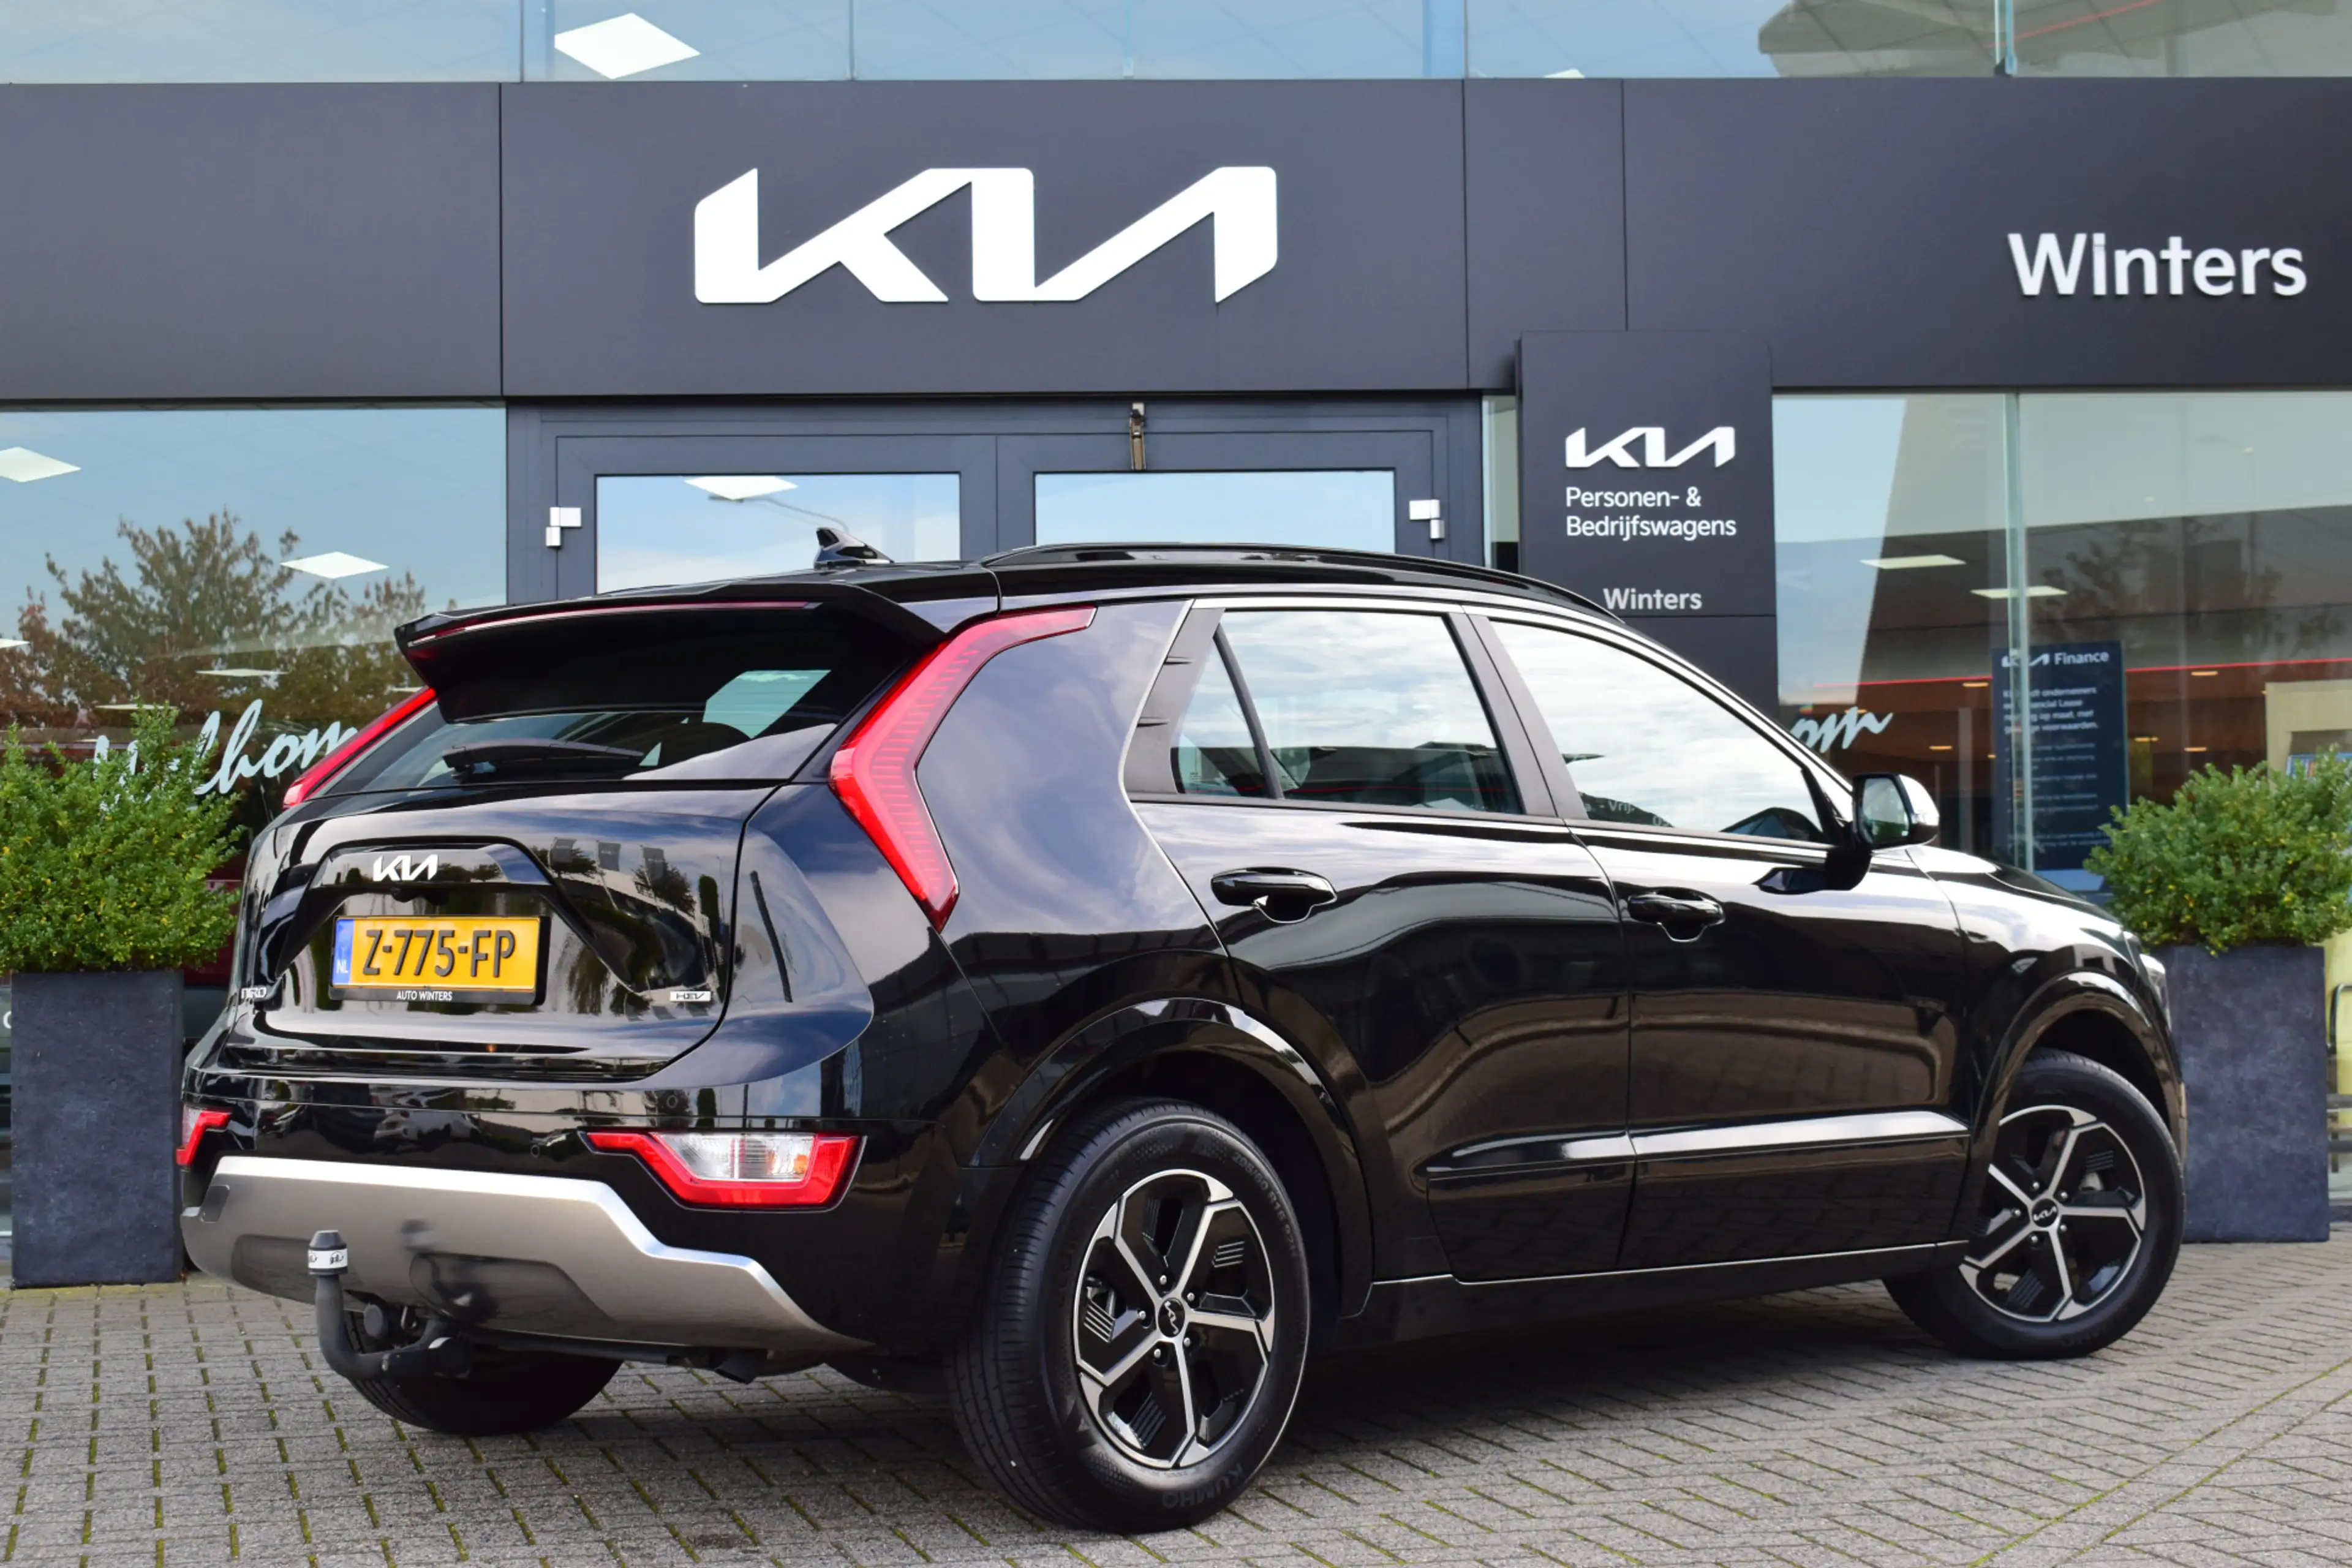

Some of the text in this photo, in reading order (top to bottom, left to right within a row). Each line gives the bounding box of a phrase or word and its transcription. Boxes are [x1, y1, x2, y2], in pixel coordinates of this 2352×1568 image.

[695, 167, 1278, 304] KIA
[2007, 233, 2307, 296] Winters
[1566, 426, 1735, 467] KIA
[1566, 486, 1702, 507] Personen- &
[1566, 515, 1737, 541] Bedrijfswagens
[1603, 587, 1703, 610] Winters
[2054, 652, 2109, 666] Finance
[372, 854, 439, 881] KIA
[336, 959, 349, 974] NL
[362, 929, 516, 978] Z-775-FP
[396, 990, 453, 1003] AUTO WINTERS
